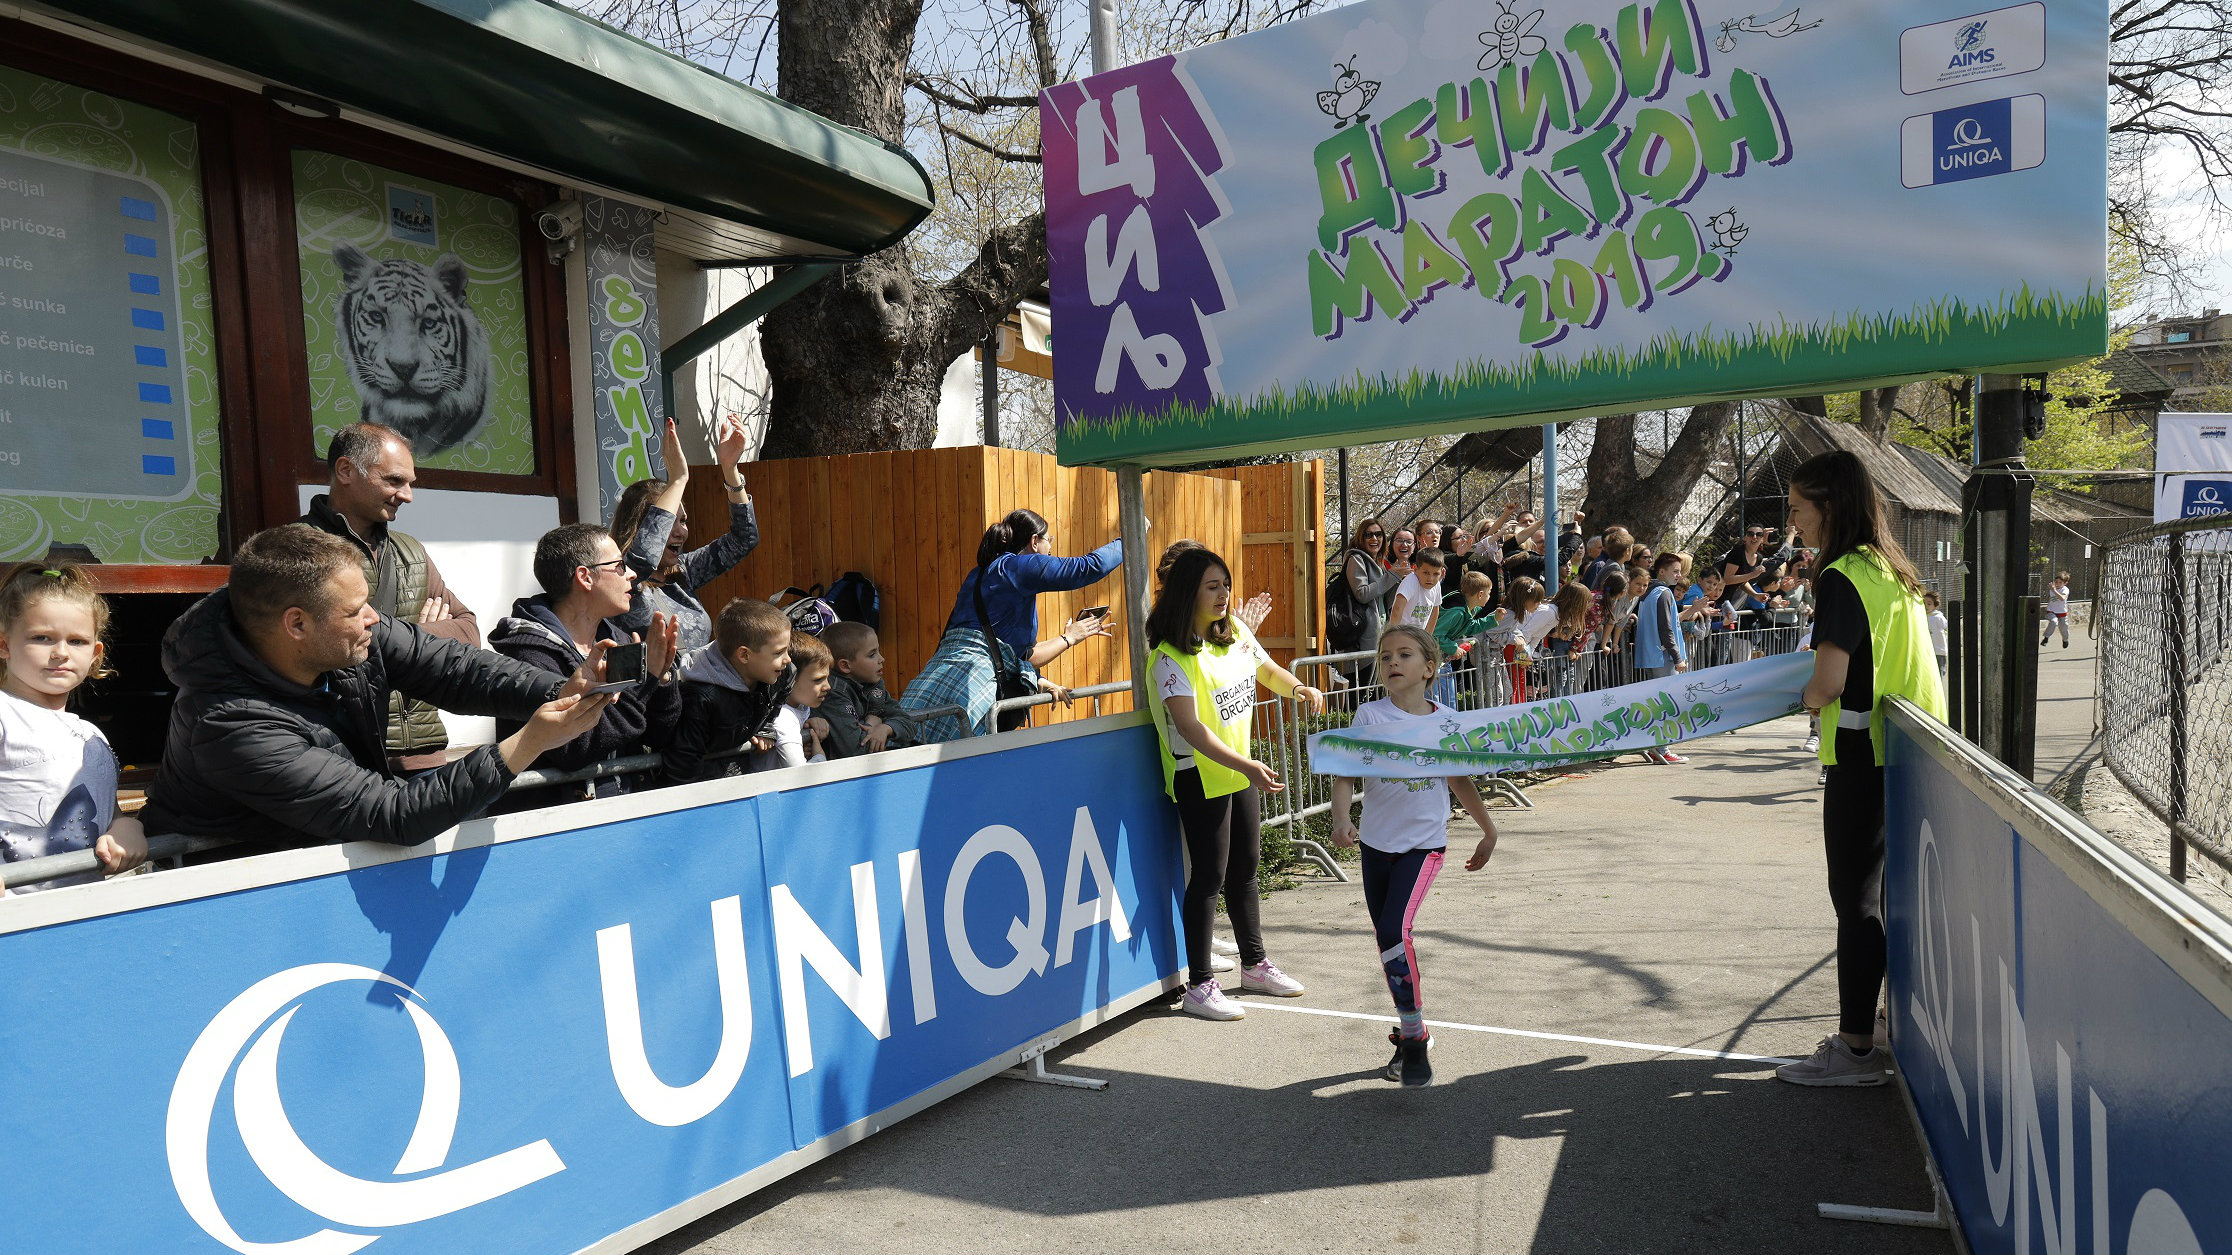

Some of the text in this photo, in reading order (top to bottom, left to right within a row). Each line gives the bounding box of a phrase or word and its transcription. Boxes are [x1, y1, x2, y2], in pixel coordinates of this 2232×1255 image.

[1314, 0, 1711, 254] ДЕЧИЈИ
[1948, 48, 1995, 69] AIMS
[1308, 67, 1794, 341] МАРАТОН
[1940, 146, 2003, 171] UNIQA
[12, 296, 67, 315] sunka
[1075, 84, 1187, 395] ЦИЉ
[1502, 206, 1732, 348] 2019.
[16, 335, 95, 356] pečenica
[19, 372, 69, 391] kulen
[596, 806, 1131, 1128] UNIQA
[1971, 912, 2203, 1255] UNI
